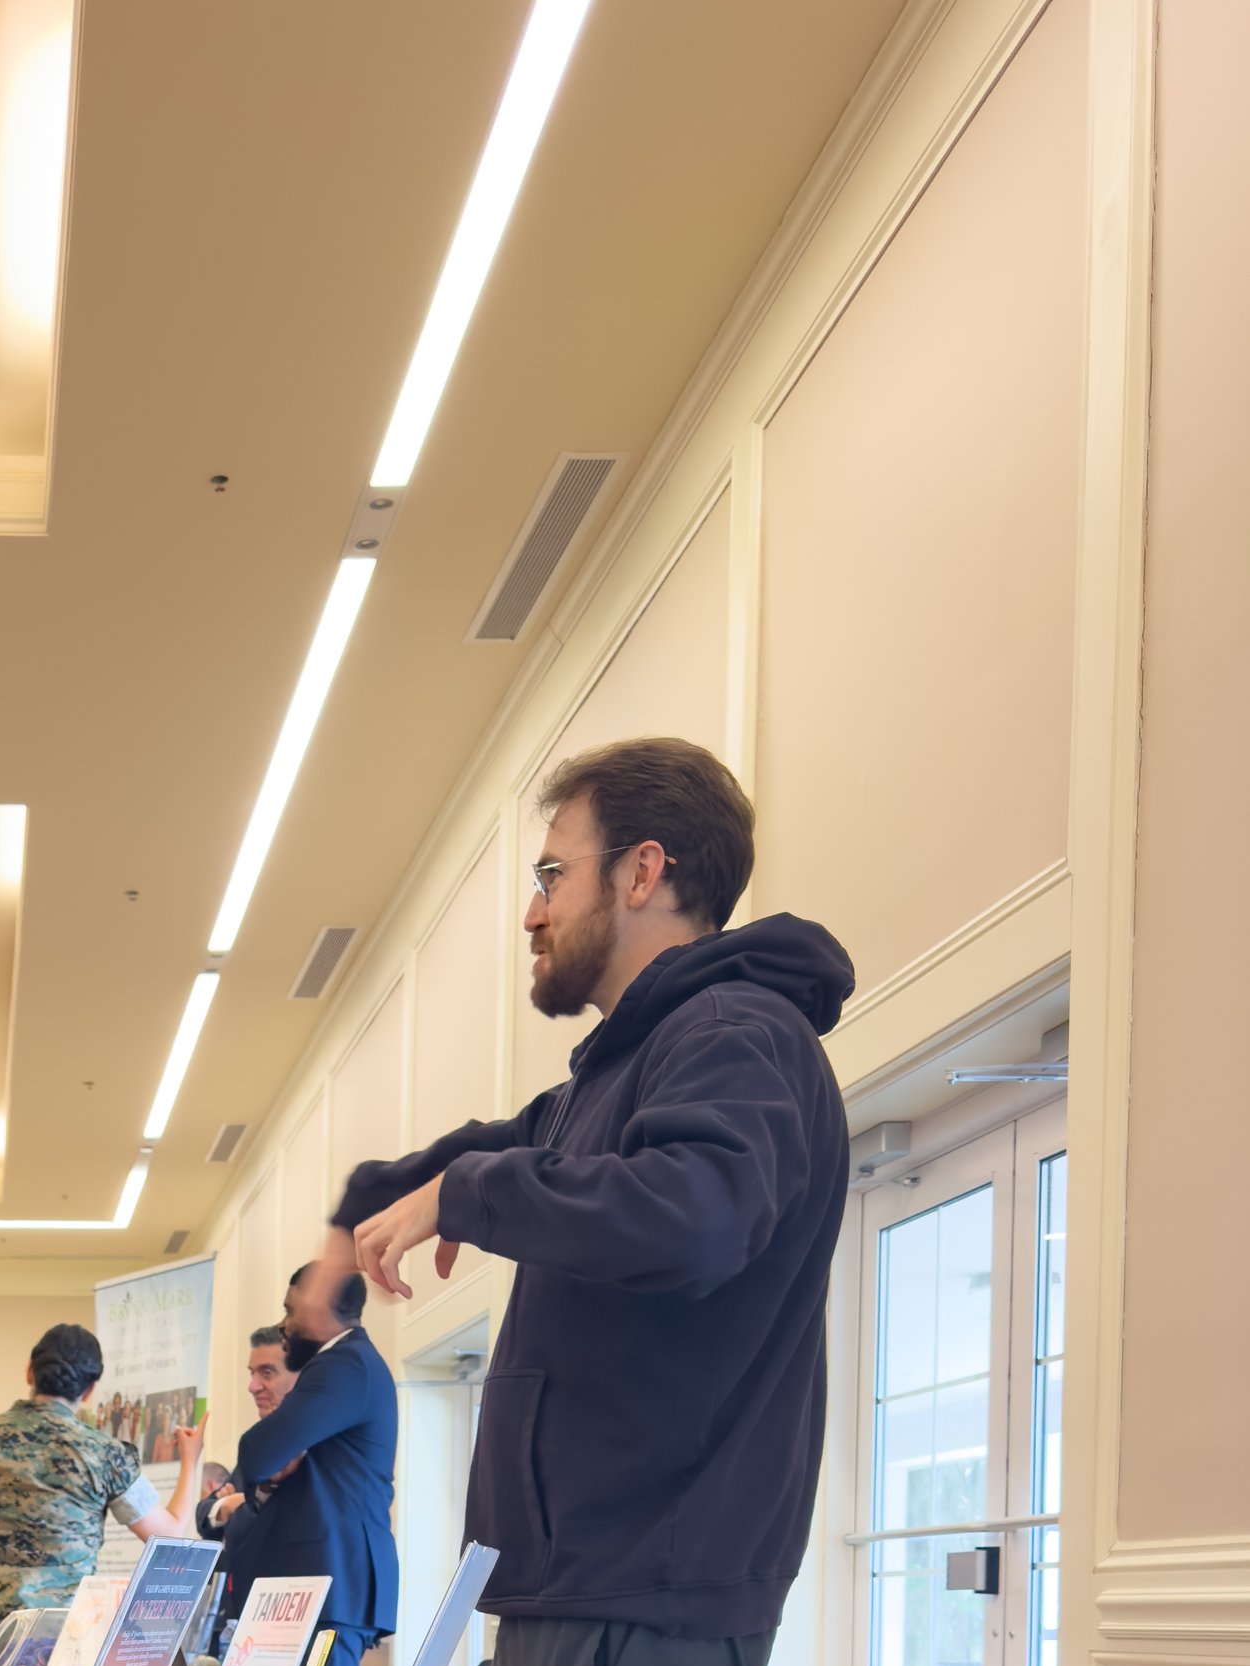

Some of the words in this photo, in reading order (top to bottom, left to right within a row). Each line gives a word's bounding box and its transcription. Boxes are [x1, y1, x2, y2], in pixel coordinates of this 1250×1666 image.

[129, 1600, 149, 1620] ON
[146, 1600, 166, 1620] THE
[162, 1600, 192, 1619] MOVE
[252, 1591, 312, 1622] TANDEM
